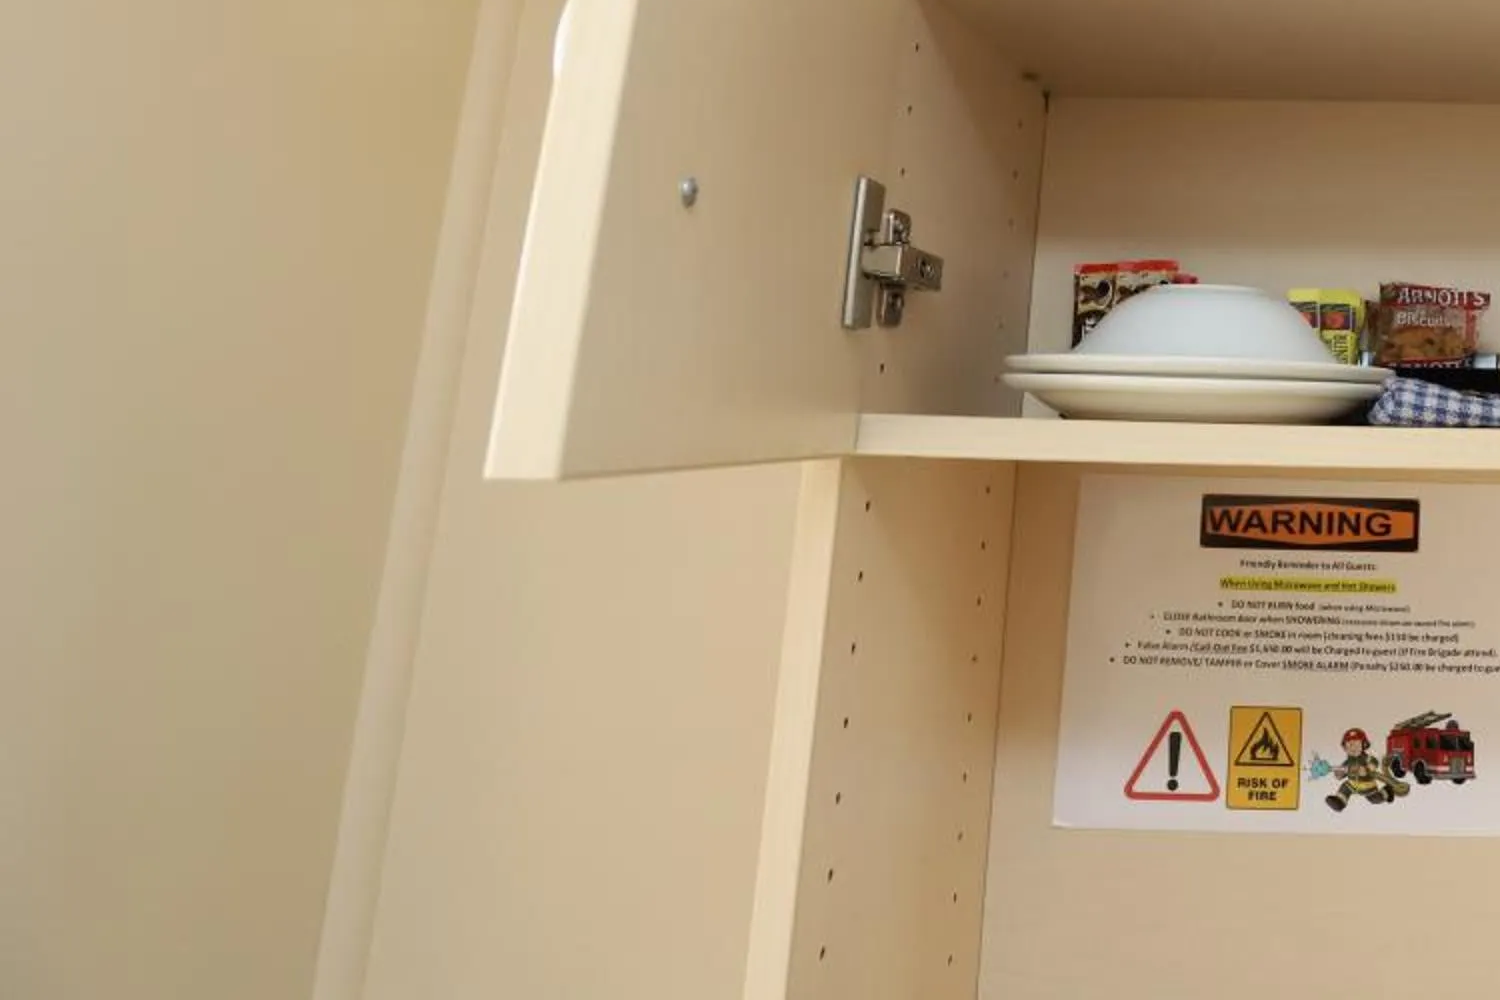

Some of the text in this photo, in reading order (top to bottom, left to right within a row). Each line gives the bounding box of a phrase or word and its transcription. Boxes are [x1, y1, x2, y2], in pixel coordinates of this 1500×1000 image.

[1208, 509, 1392, 536] WARNING
[1240, 560, 1276, 570] Friendly
[1277, 560, 1319, 569] Reminder
[1332, 561, 1345, 570] All
[1324, 582, 1341, 591] and
[1231, 600, 1245, 609] DO
[1247, 600, 1265, 609] NOT
[1267, 601, 1293, 610] BURN
[1295, 601, 1315, 610] food
[1237, 614, 1257, 623] door
[1258, 615, 1284, 624] when
[1285, 615, 1341, 625] SHOWERING
[1178, 627, 1193, 637] DO
[1194, 627, 1214, 637] NOT
[1215, 628, 1241, 638] COOK
[1254, 629, 1286, 639] SMOKE
[1294, 645, 1311, 653] will
[1311, 645, 1323, 655] be
[1324, 645, 1362, 657] Charged
[1428, 648, 1462, 659] Brigade
[1123, 655, 1137, 665] DO
[1138, 655, 1159, 665] NOT
[1204, 657, 1242, 668] TAMPER
[1255, 659, 1281, 669] Cover
[1281, 660, 1314, 671] SMOKE
[1315, 661, 1349, 671] ALARM
[1437, 663, 1473, 674] charged
[1237, 777, 1290, 789] RISK OF
[1247, 790, 1277, 801] FIRE
